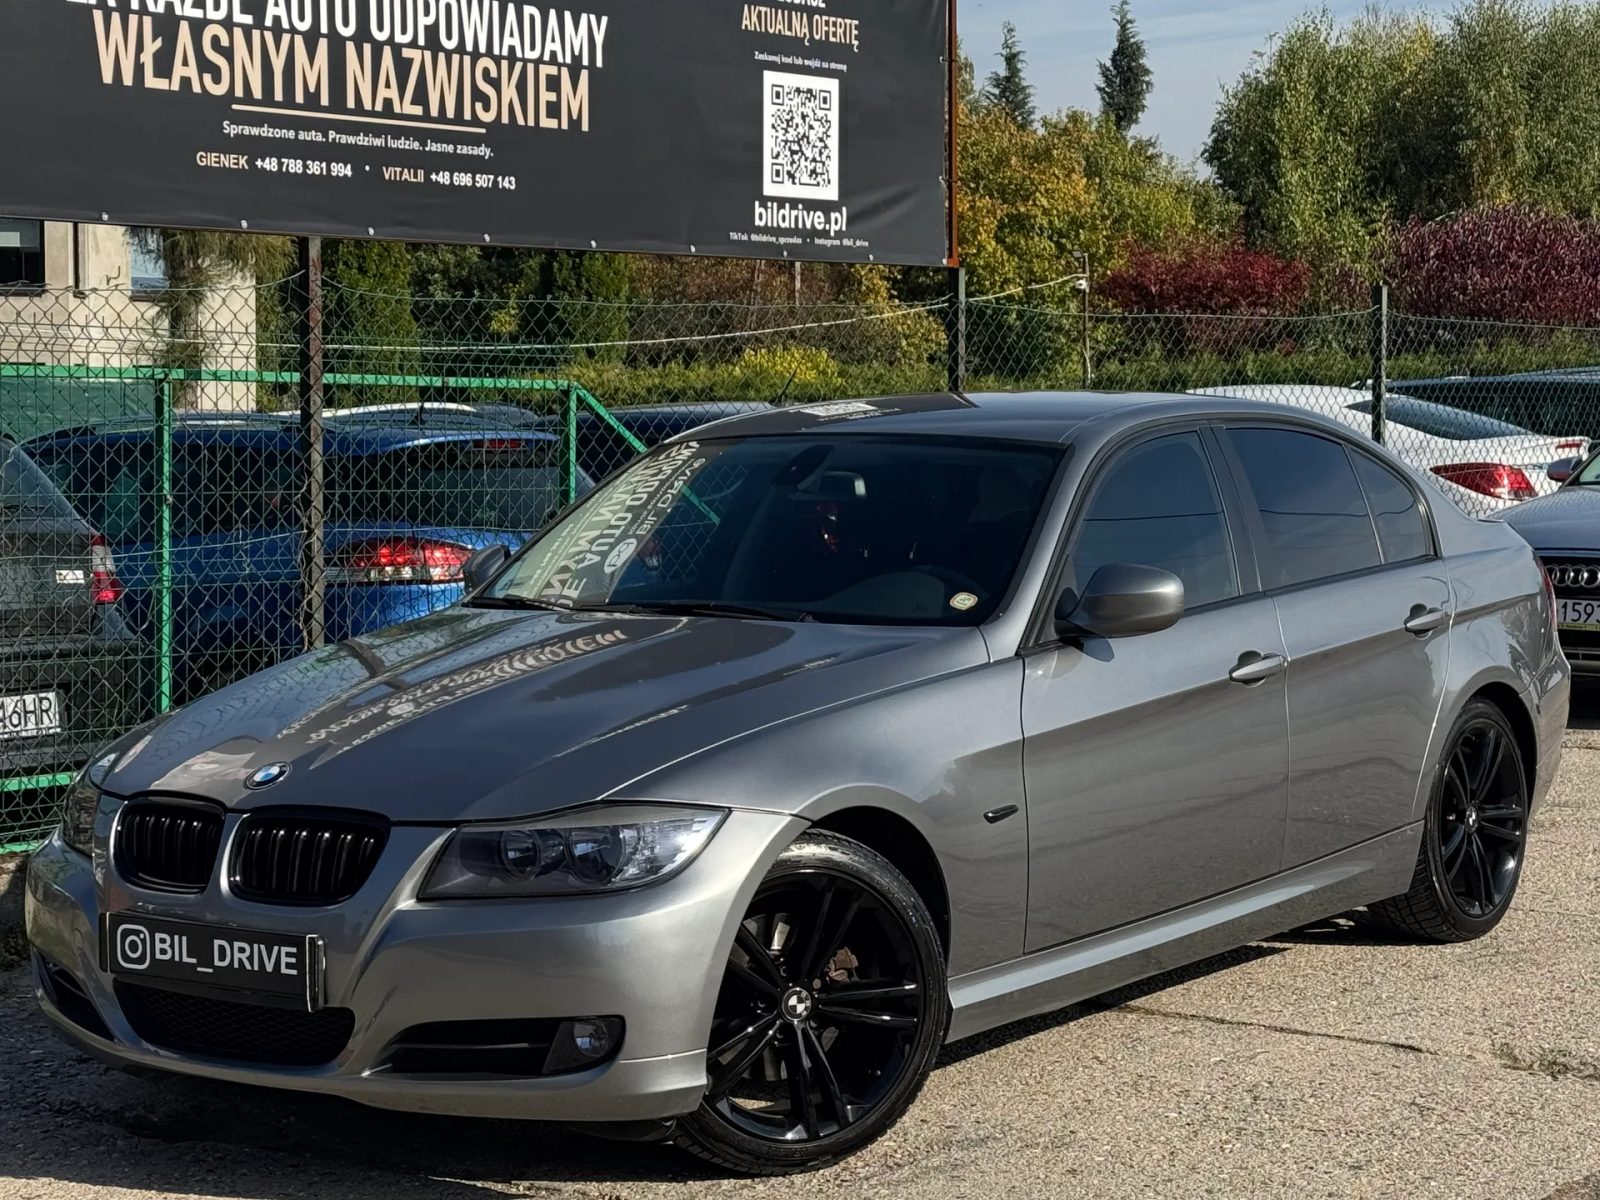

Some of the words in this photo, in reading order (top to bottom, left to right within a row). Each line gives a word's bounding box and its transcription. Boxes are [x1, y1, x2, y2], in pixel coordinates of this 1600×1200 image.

[369, 0, 608, 68] ODPOWIADAMY
[741, 4, 810, 46] AKTUALNĄ
[813, 14, 859, 52] OFERTĘ
[93, 8, 329, 107] WŁASNYM
[345, 40, 589, 132] NAZWISKIEM
[754, 51, 781, 65] Zeskanuj
[782, 54, 793, 64] kod
[794, 55, 803, 65] lub
[822, 61, 829, 69] na
[222, 120, 296, 139] Sprawdzone
[298, 129, 326, 142] auta.
[328, 130, 385, 147] Prawdziwi
[387, 134, 423, 151] ludzie.
[425, 139, 455, 153] Jasne
[456, 143, 494, 159] zasady.
[196, 151, 249, 169] GIENEK
[255, 157, 278, 172] +48
[281, 158, 303, 174] 788
[306, 160, 327, 175] 361
[331, 162, 352, 177] 994
[382, 166, 424, 183] VITALII
[430, 170, 451, 185] +48
[453, 172, 473, 187] 696
[475, 174, 494, 188] 507
[497, 175, 516, 190] 143
[729, 232, 749, 241] TikTok
[754, 200, 847, 237] bildrive.pl
[154, 932, 298, 976] BIL_DRIVE
